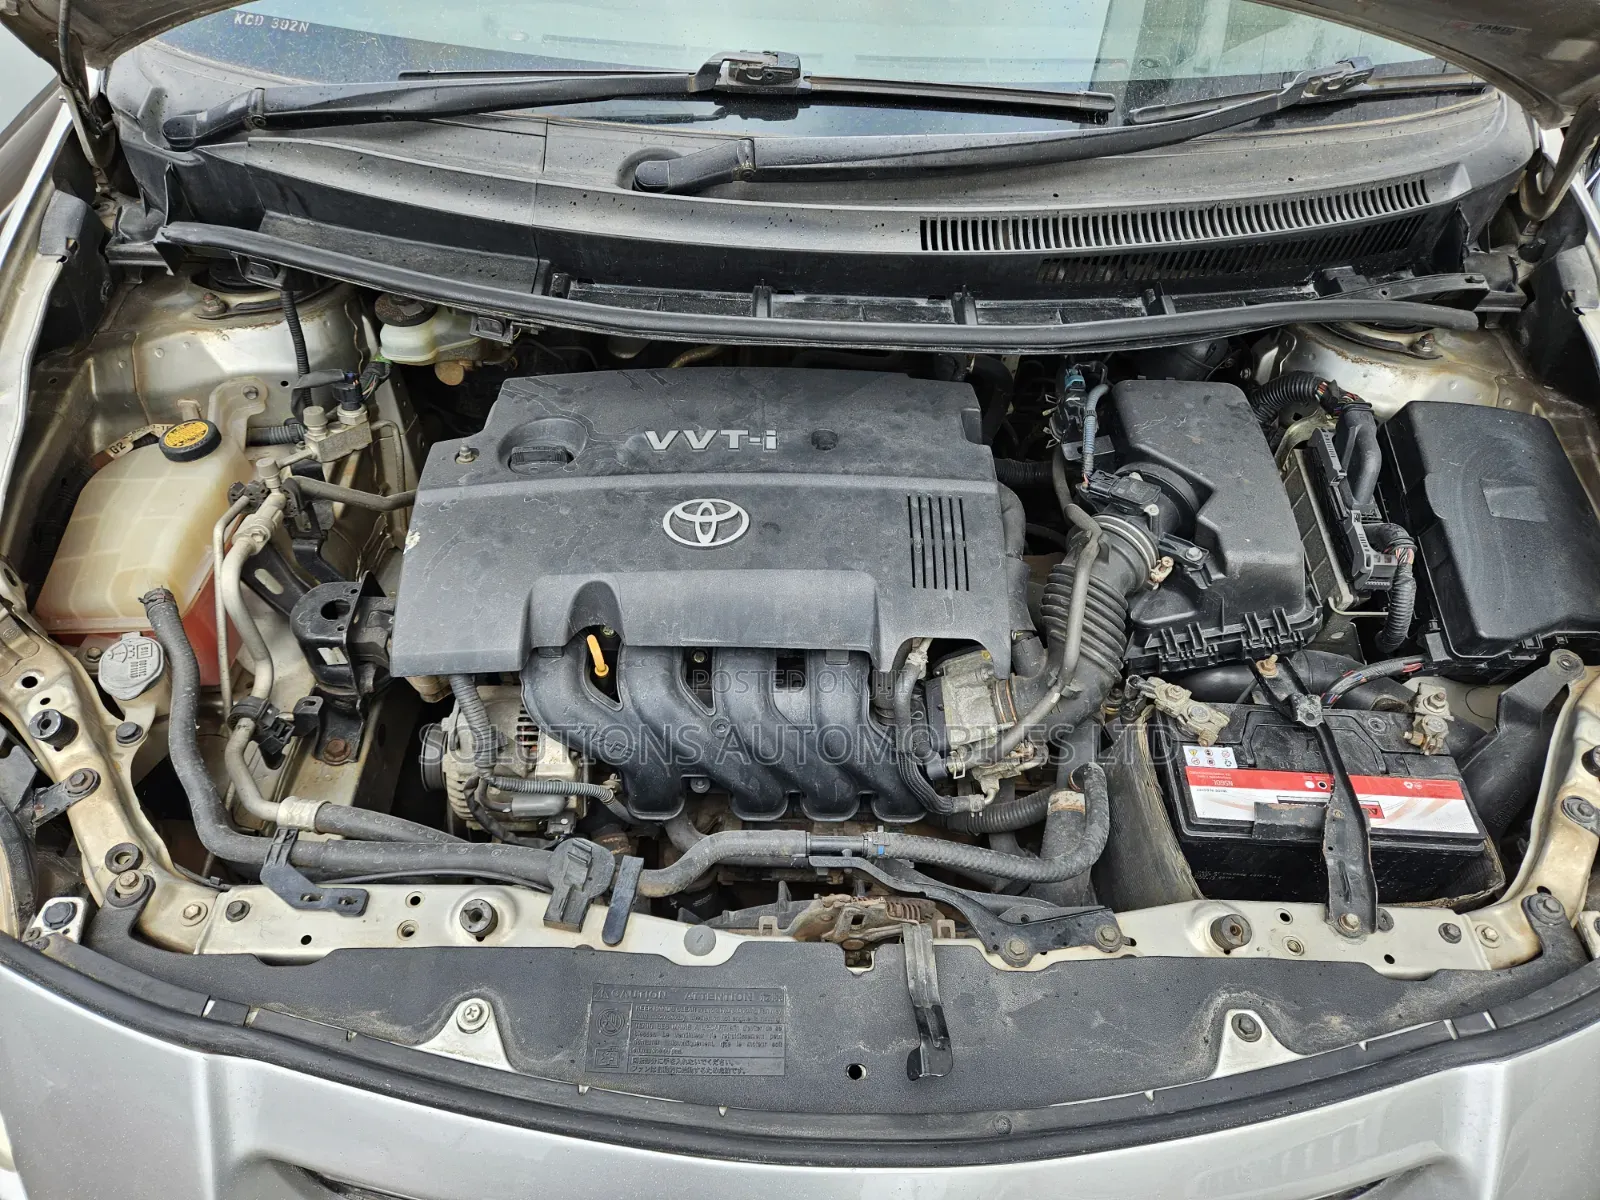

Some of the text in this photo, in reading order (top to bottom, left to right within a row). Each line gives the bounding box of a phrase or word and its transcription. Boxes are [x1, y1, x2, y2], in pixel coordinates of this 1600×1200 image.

[644, 429, 778, 451] VVT-i
[109, 441, 127, 455] G2
[610, 989, 668, 1000] CAUTION
[684, 992, 754, 1002] ATTENTION
